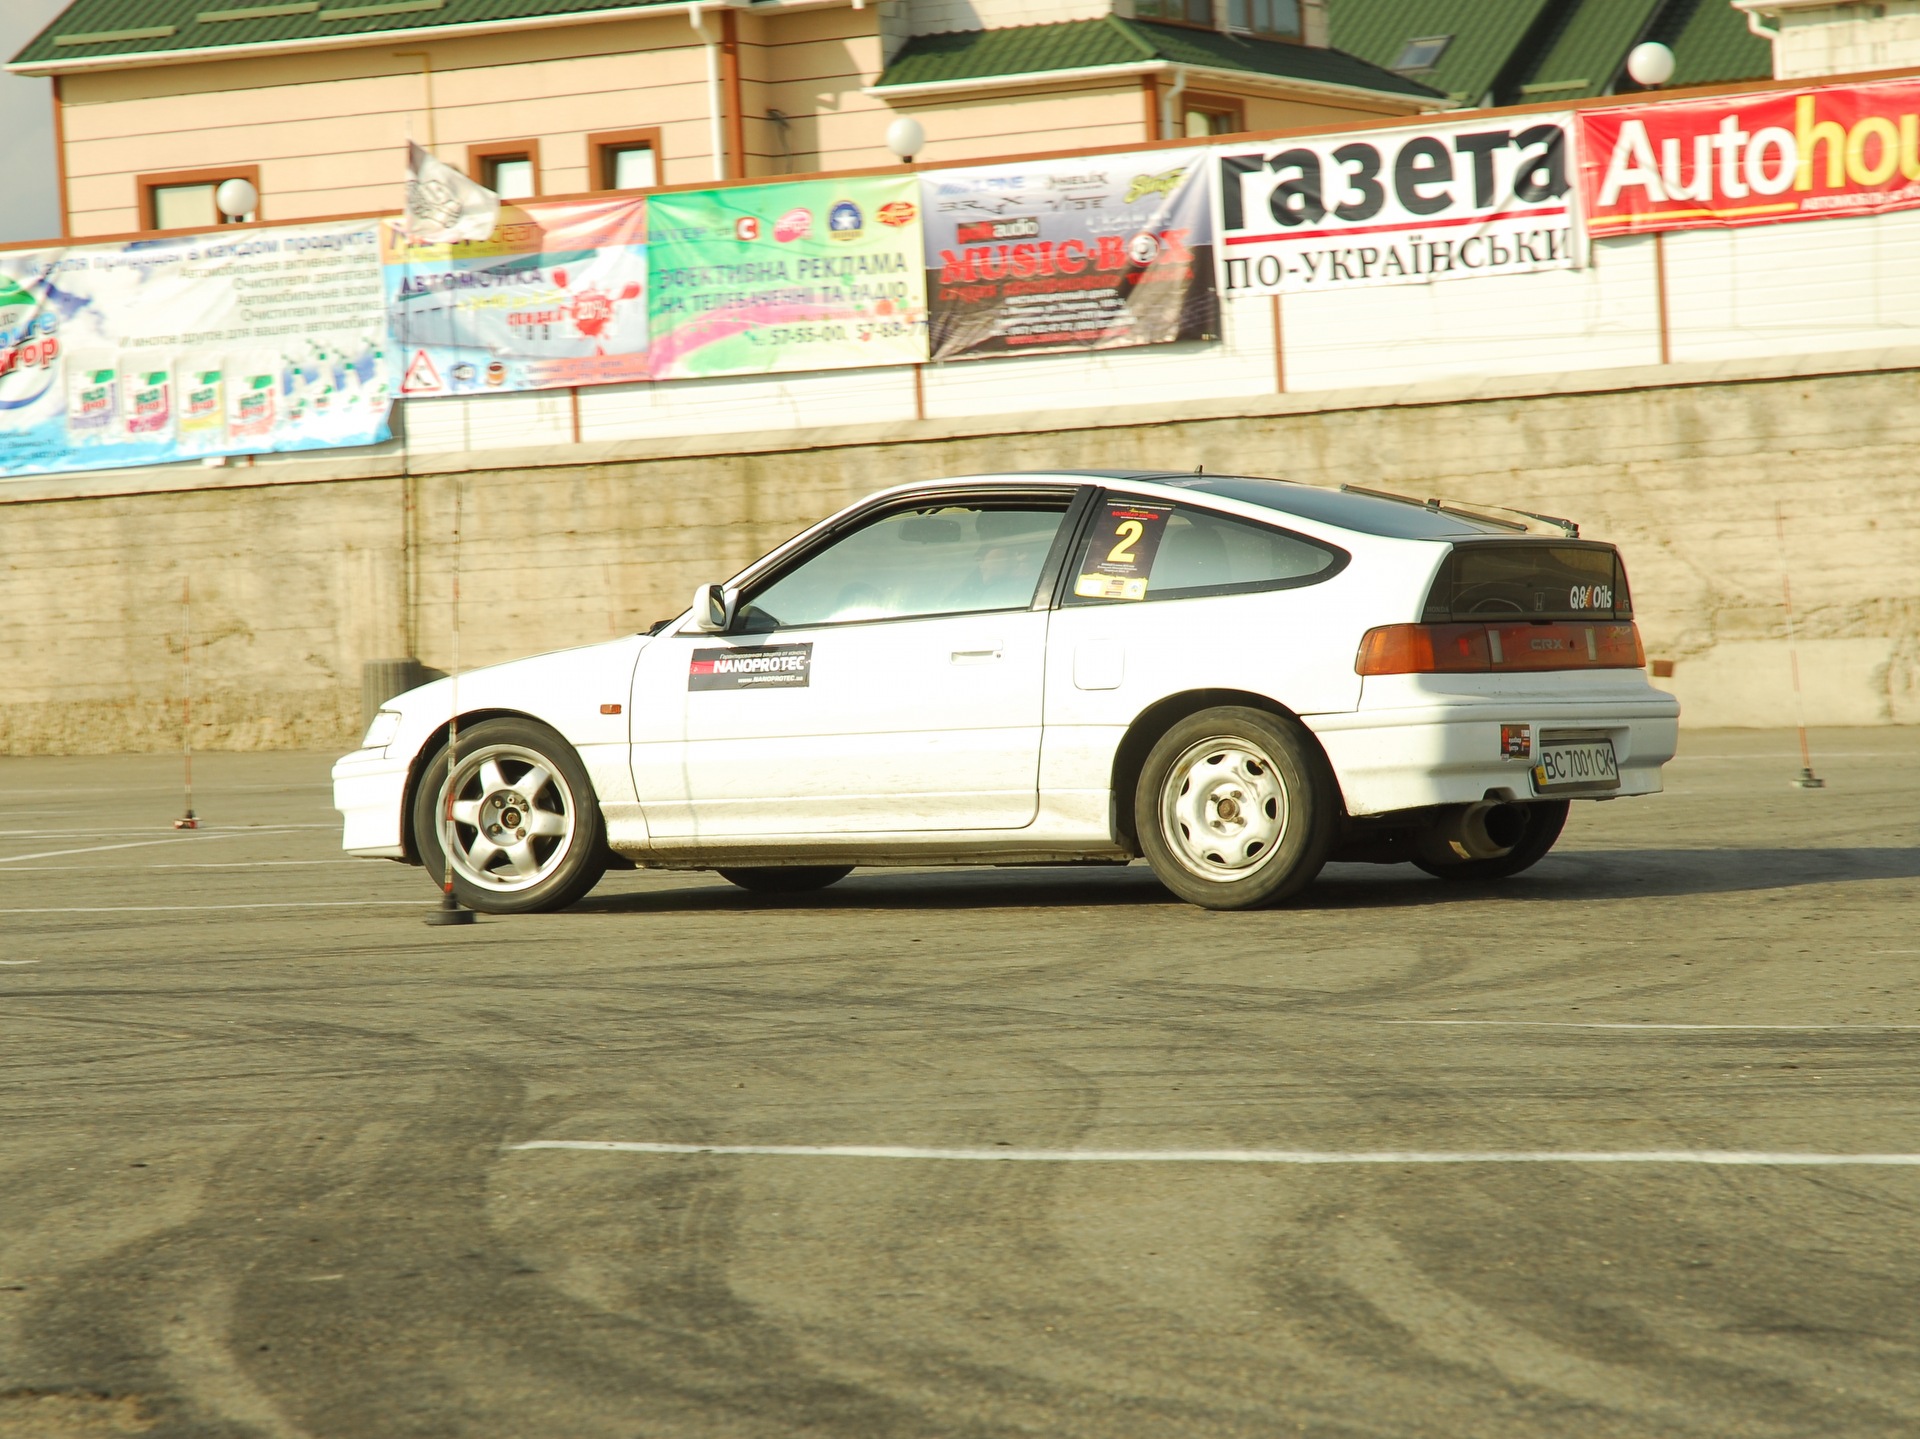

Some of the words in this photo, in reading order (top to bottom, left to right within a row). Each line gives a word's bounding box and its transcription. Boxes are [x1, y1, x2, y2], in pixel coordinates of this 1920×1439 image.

[1220, 124, 1573, 230] газета
[797, 253, 909, 280] РЕКЛАМА
[1224, 229, 1573, 290] ПО-УКРАЇНСЬКИ
[822, 286, 845, 302] ТА
[1106, 520, 1144, 562] 2
[1593, 585, 1612, 608] Oils
[1530, 638, 1563, 650] CRX
[713, 656, 805, 673] NANOPROTEC
